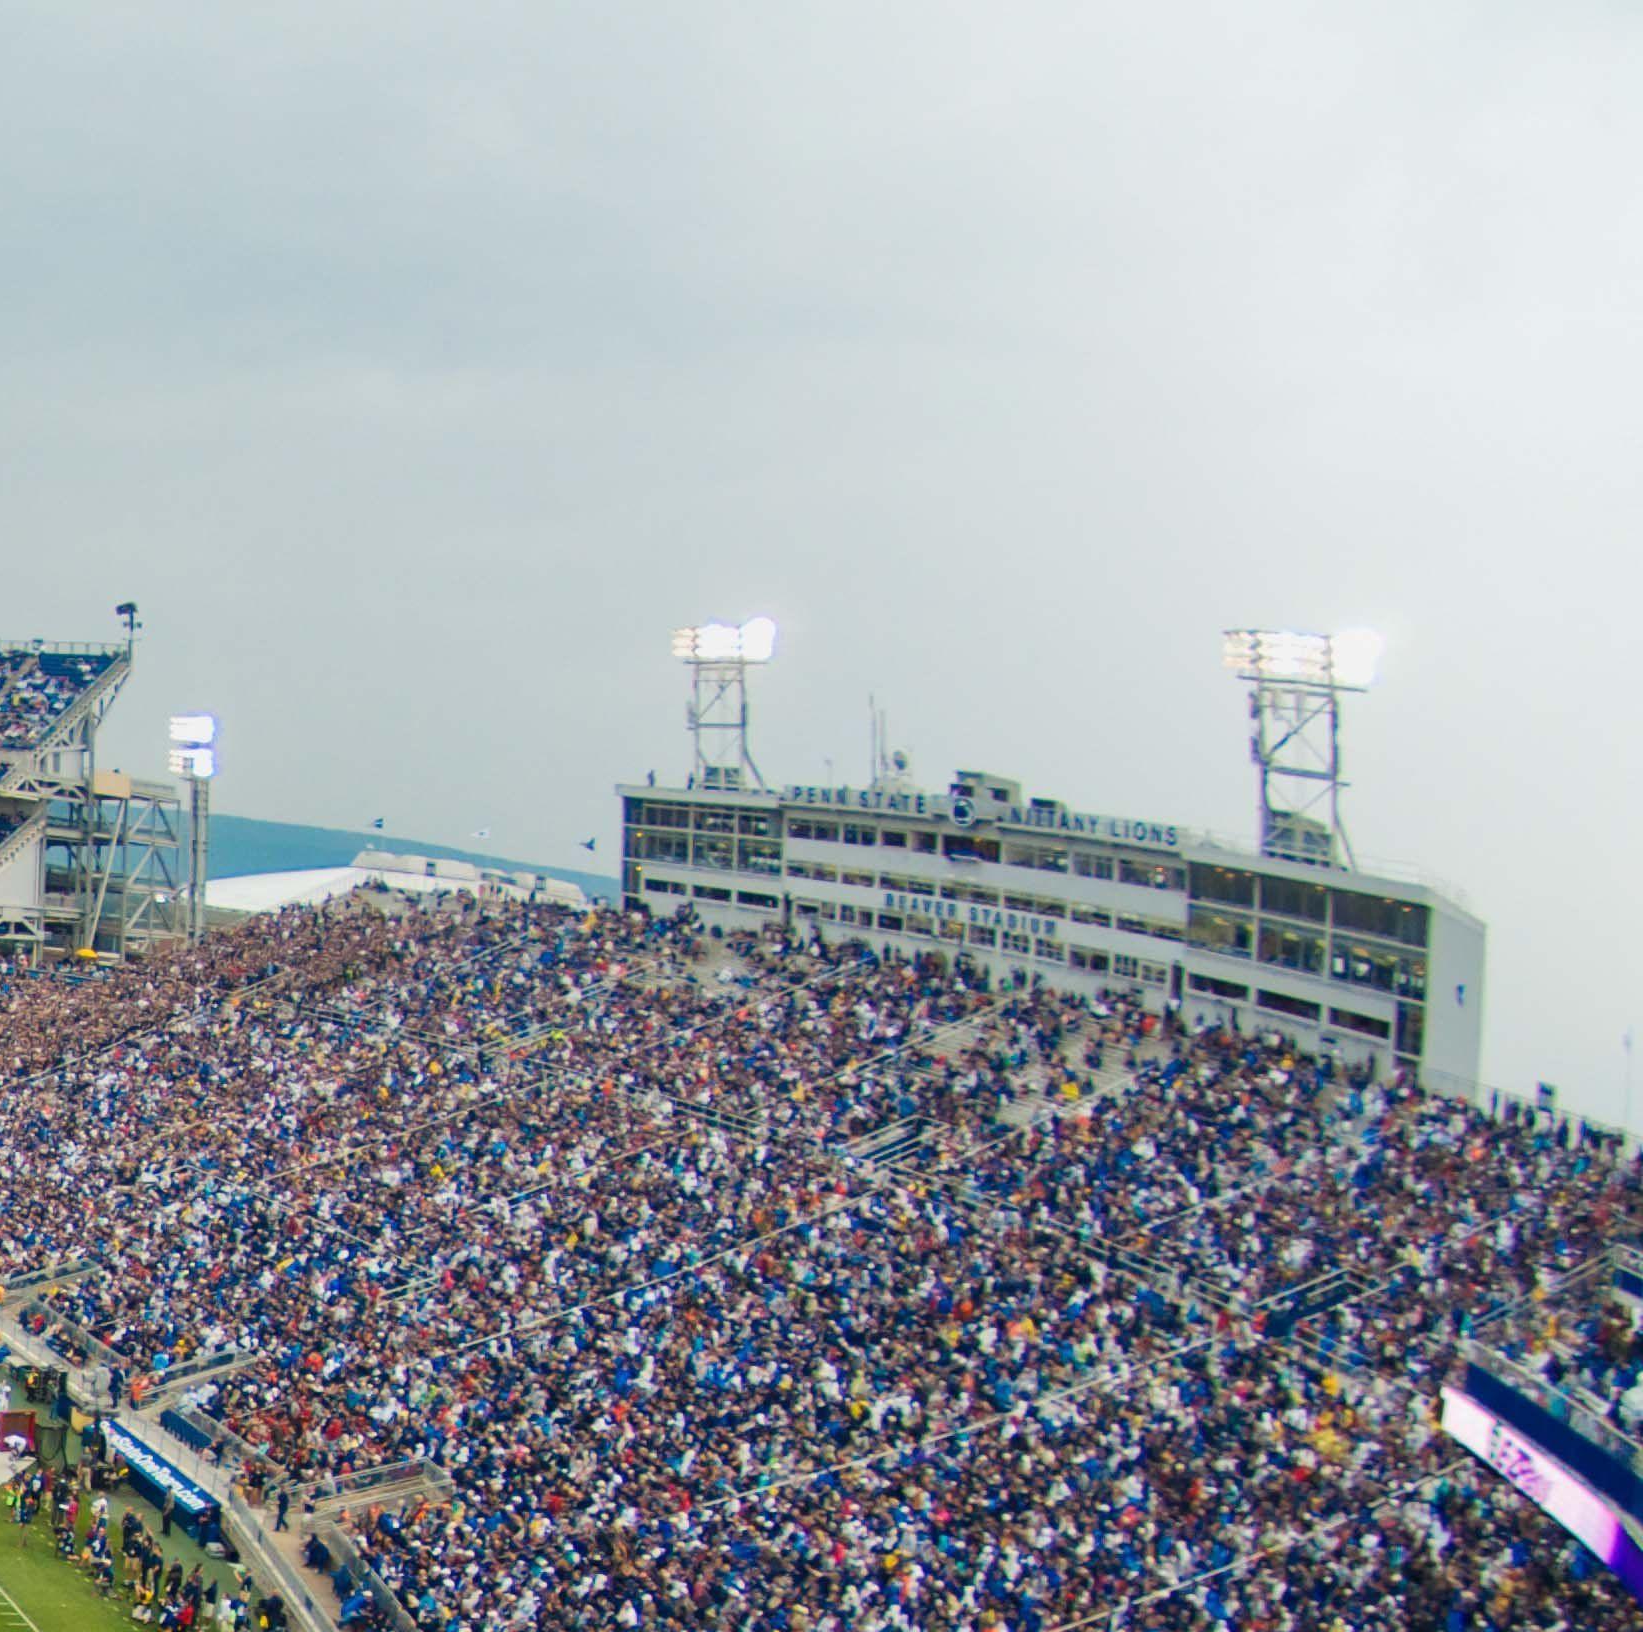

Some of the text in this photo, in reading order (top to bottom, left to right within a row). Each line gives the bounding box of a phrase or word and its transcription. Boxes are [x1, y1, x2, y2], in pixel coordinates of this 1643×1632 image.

[793, 784, 1178, 847] PENN STATE NITTANY LIONS
[884, 892, 1056, 936] BEAVER STADIUM
